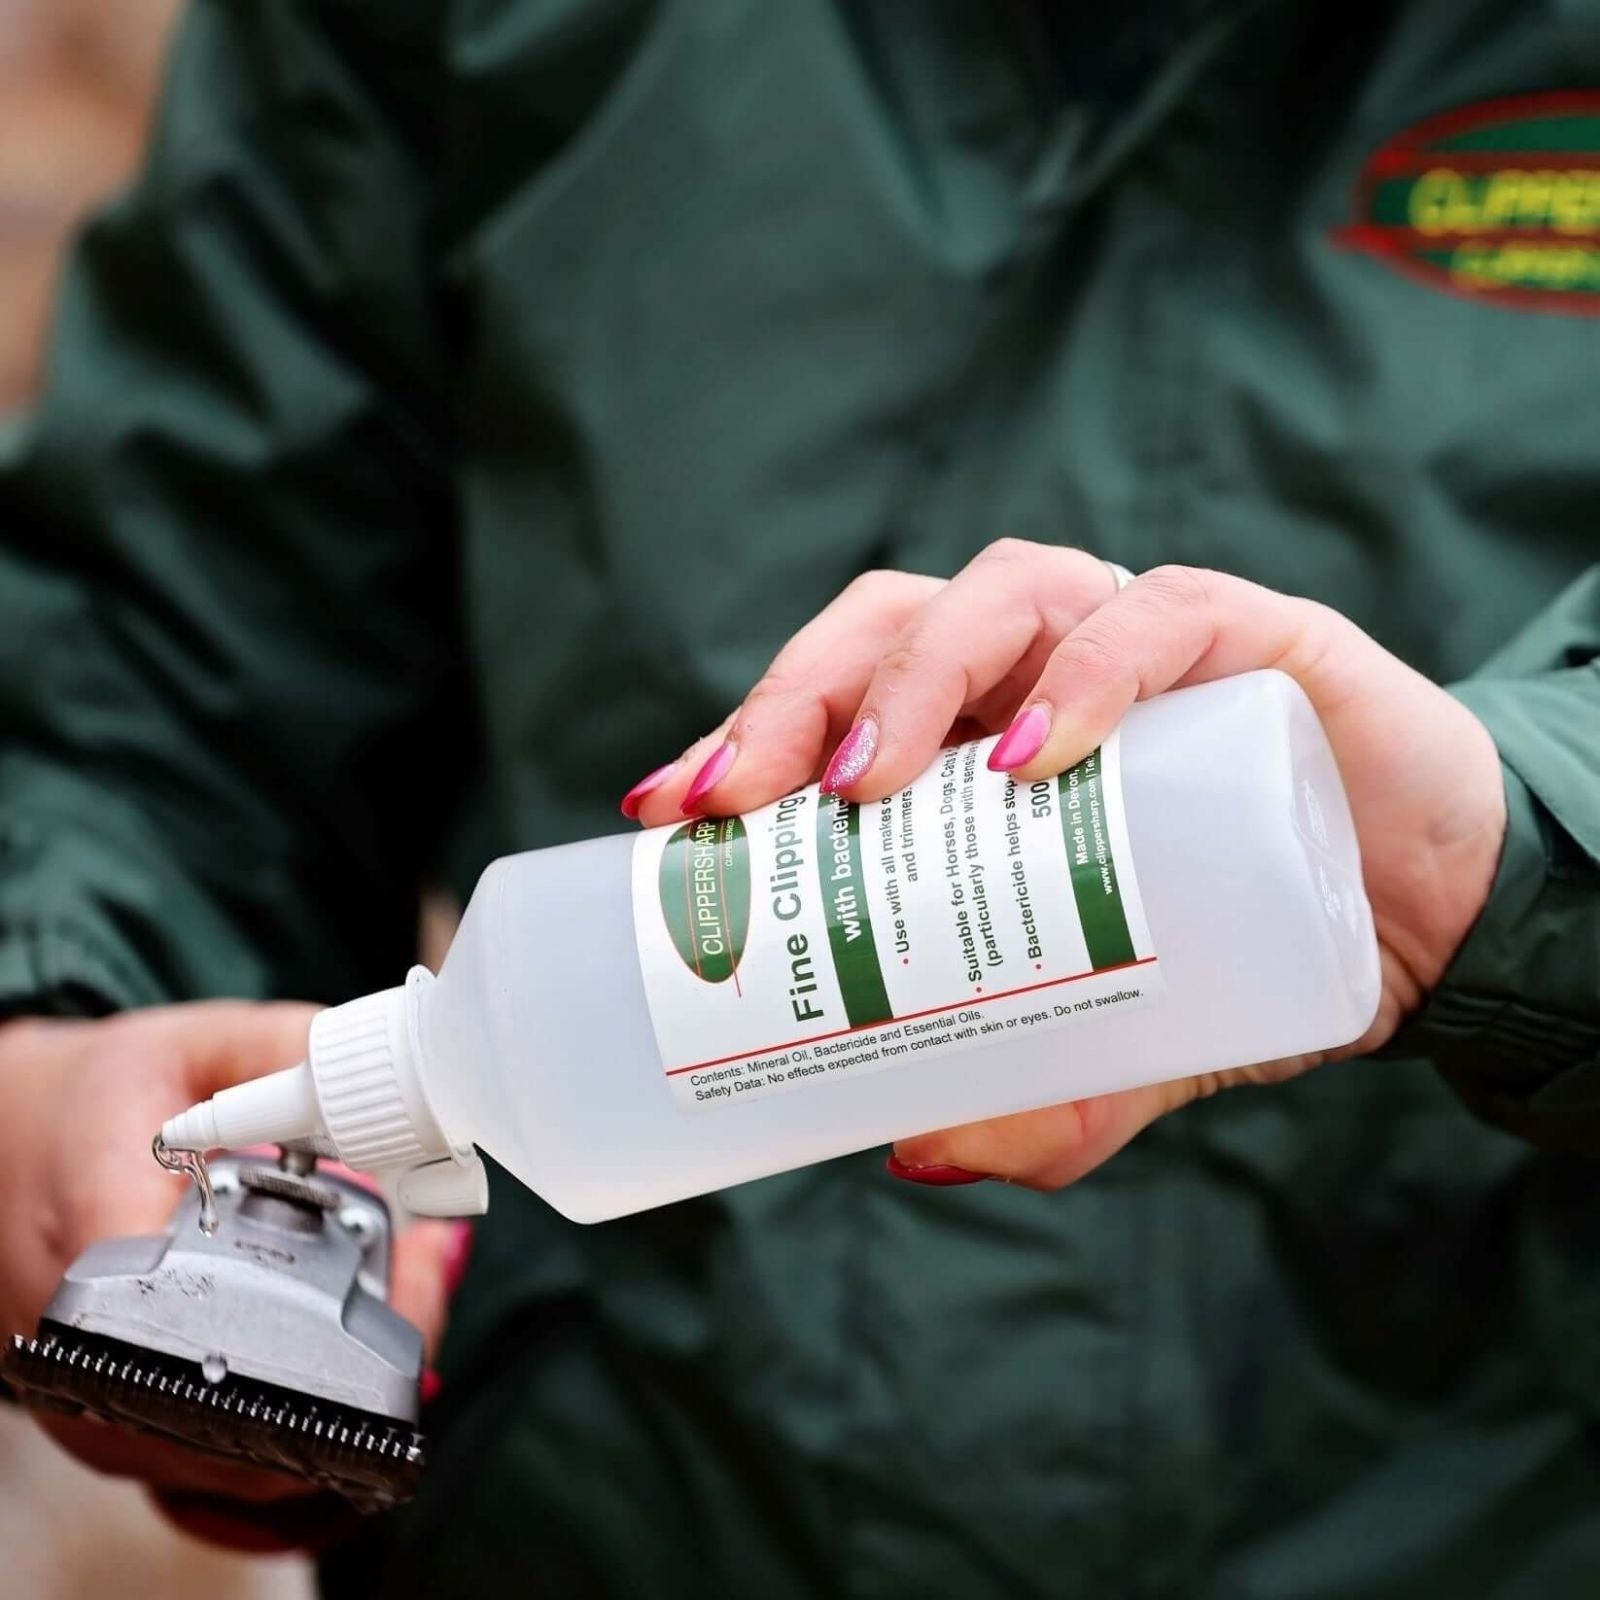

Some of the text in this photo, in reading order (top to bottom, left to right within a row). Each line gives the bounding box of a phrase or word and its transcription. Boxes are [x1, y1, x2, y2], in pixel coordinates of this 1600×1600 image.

[940, 779, 956, 815] Dogs,
[941, 757, 956, 778] Cats
[961, 784, 977, 816] with
[880, 807, 894, 853] makes
[900, 786, 918, 883] and trimmers.
[943, 817, 959, 878] Horses,
[964, 817, 979, 860] those
[1068, 769, 1089, 865] Made in Devon,
[1088, 779, 1113, 895] www.clippersharp.com
[694, 821, 724, 955] CLIPPERSHARP
[829, 790, 862, 942] with bacterici
[880, 855, 896, 877] all
[885, 878, 902, 916] with
[951, 882, 965, 908] for
[1003, 780, 1043, 960] Bactericide helps stop
[768, 796, 824, 1022] Fine Clipping
[894, 919, 910, 954] Use
[967, 864, 1005, 968] (particularly
[956, 910, 983, 983] Suitable
[690, 1009, 985, 1087] Contents: Mineral Oil, Bactericide and Essential Oils.
[695, 988, 1144, 1102] Safety Data: No effects expected from contact with skin or eyes. Do not swallow.
